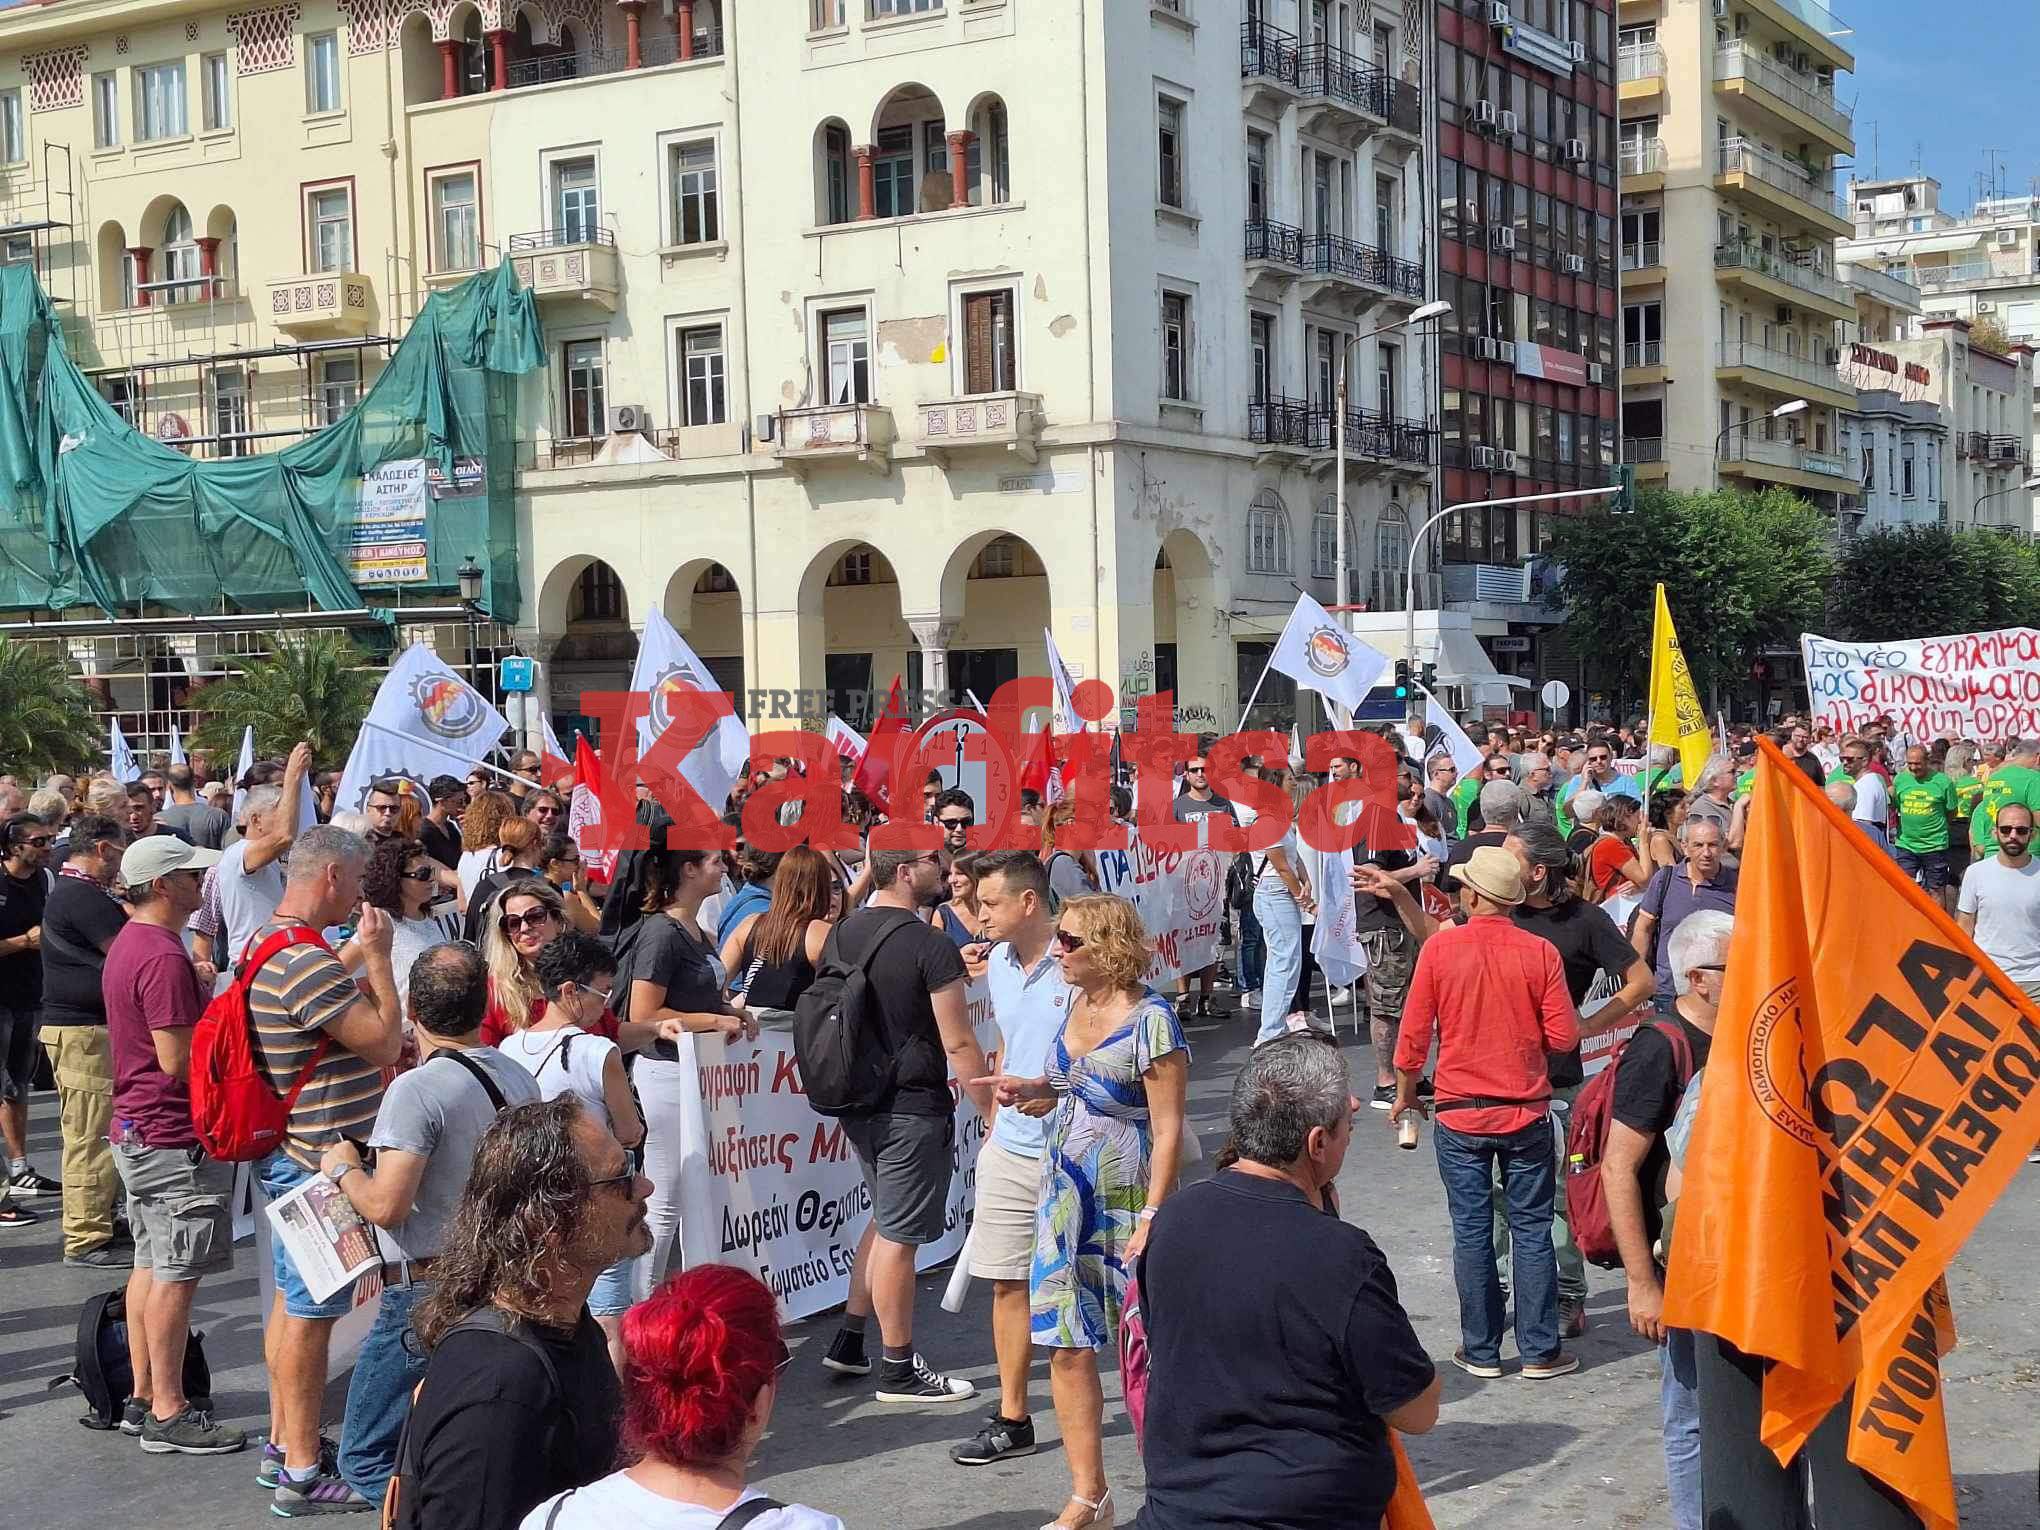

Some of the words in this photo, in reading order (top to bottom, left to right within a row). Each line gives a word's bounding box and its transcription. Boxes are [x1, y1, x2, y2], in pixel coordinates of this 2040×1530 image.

[376, 483, 408, 495] ΑΣΤΗΡ
[1808, 638, 1850, 668] Στο
[1808, 670, 1859, 702] μας
[933, 731, 946, 750] 11
[952, 723, 970, 743] 12
[771, 1050, 810, 1095] Κ
[708, 1124, 800, 1182] Αυξήσεις
[808, 1121, 851, 1164] Μι
[720, 1192, 789, 1258] Δωρεάν
[829, 1243, 856, 1277] Ερ
